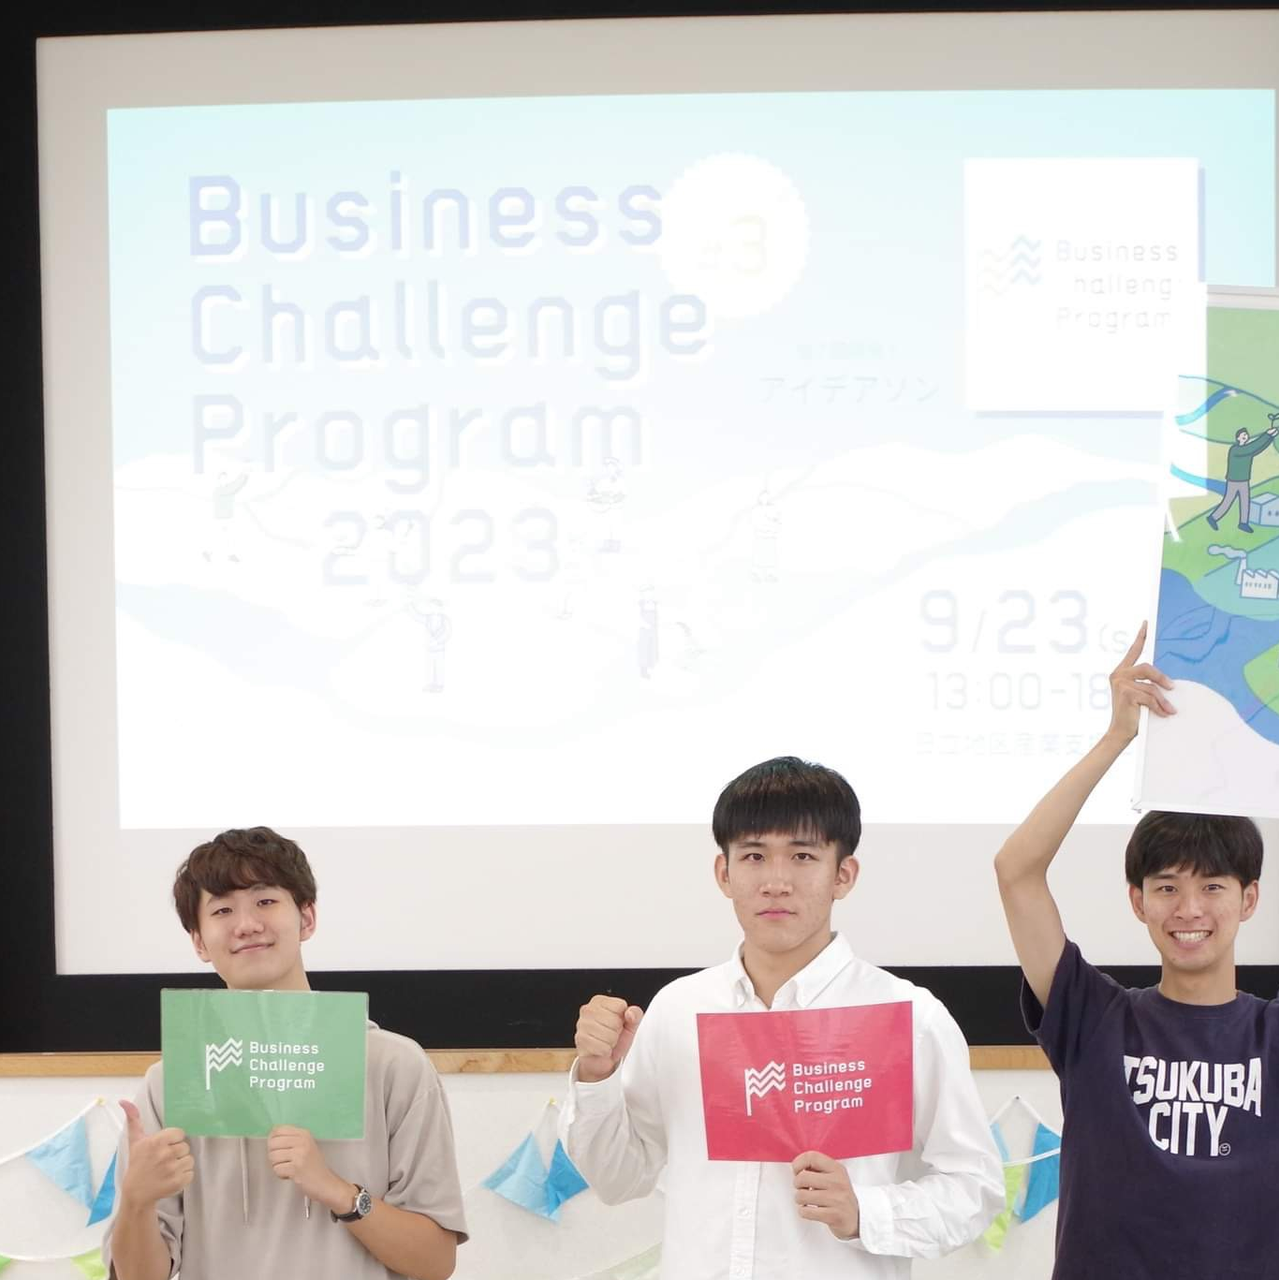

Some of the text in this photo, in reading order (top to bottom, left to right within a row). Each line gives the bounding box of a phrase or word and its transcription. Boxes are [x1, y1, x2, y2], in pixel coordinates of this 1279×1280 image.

[187, 170, 665, 259] Business
[1055, 239, 1179, 262] Business
[190, 280, 710, 382] Challenge
[192, 392, 645, 495] Program
[322, 508, 562, 586] 2023
[249, 1041, 320, 1056] Business
[249, 1058, 325, 1075] Challenge
[792, 1060, 866, 1078] Business
[249, 1076, 317, 1092] Program
[793, 1077, 873, 1096] Challenge
[794, 1096, 864, 1115] Program
[1148, 1101, 1229, 1157] CITY
